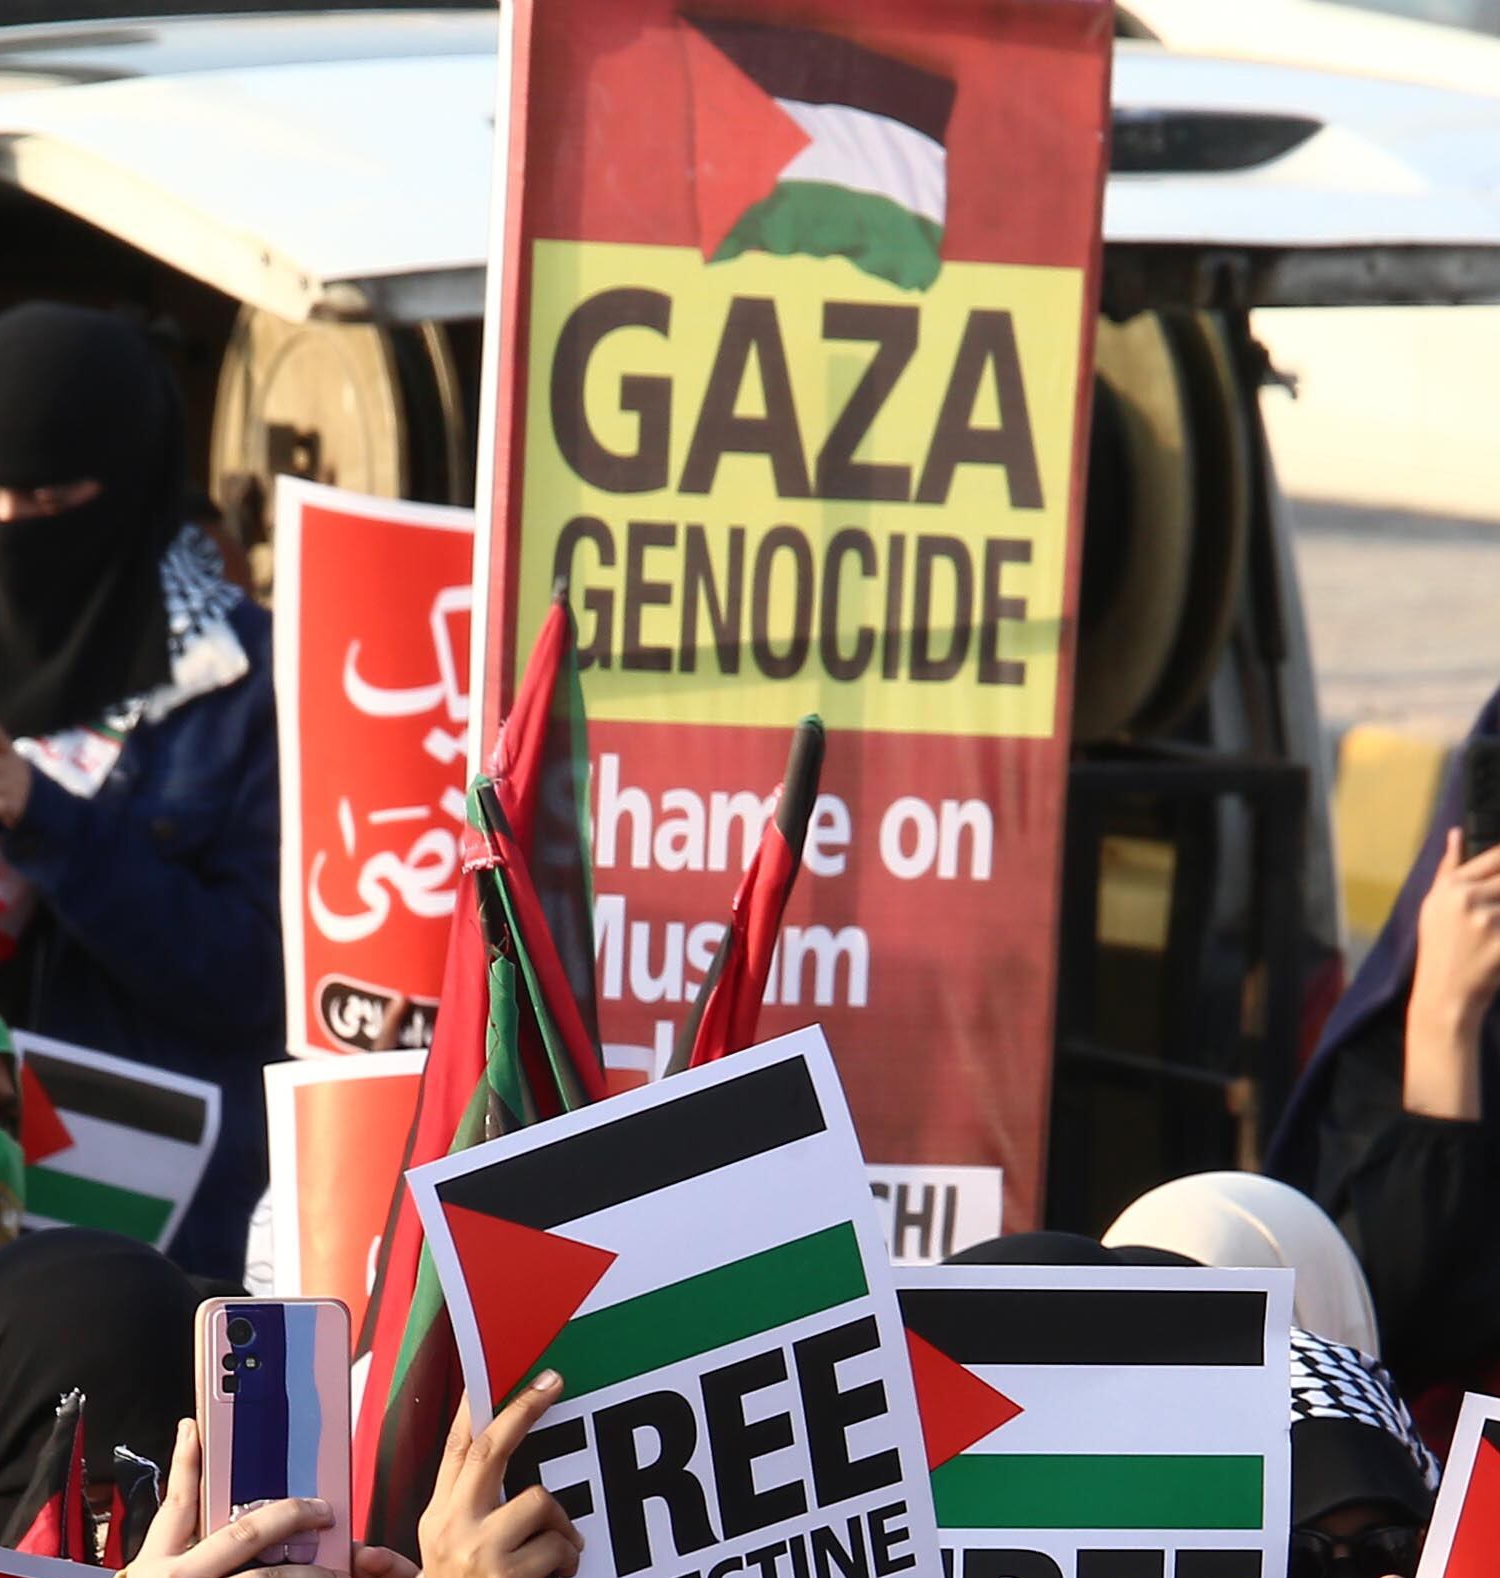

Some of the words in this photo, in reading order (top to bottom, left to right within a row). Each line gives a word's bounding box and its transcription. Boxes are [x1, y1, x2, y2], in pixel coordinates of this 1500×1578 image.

[549, 286, 1046, 510] GAZA
[552, 515, 1034, 688] GENOCIDE
[588, 753, 852, 878] hame
[879, 795, 995, 881] on
[870, 1182, 958, 1259] HI
